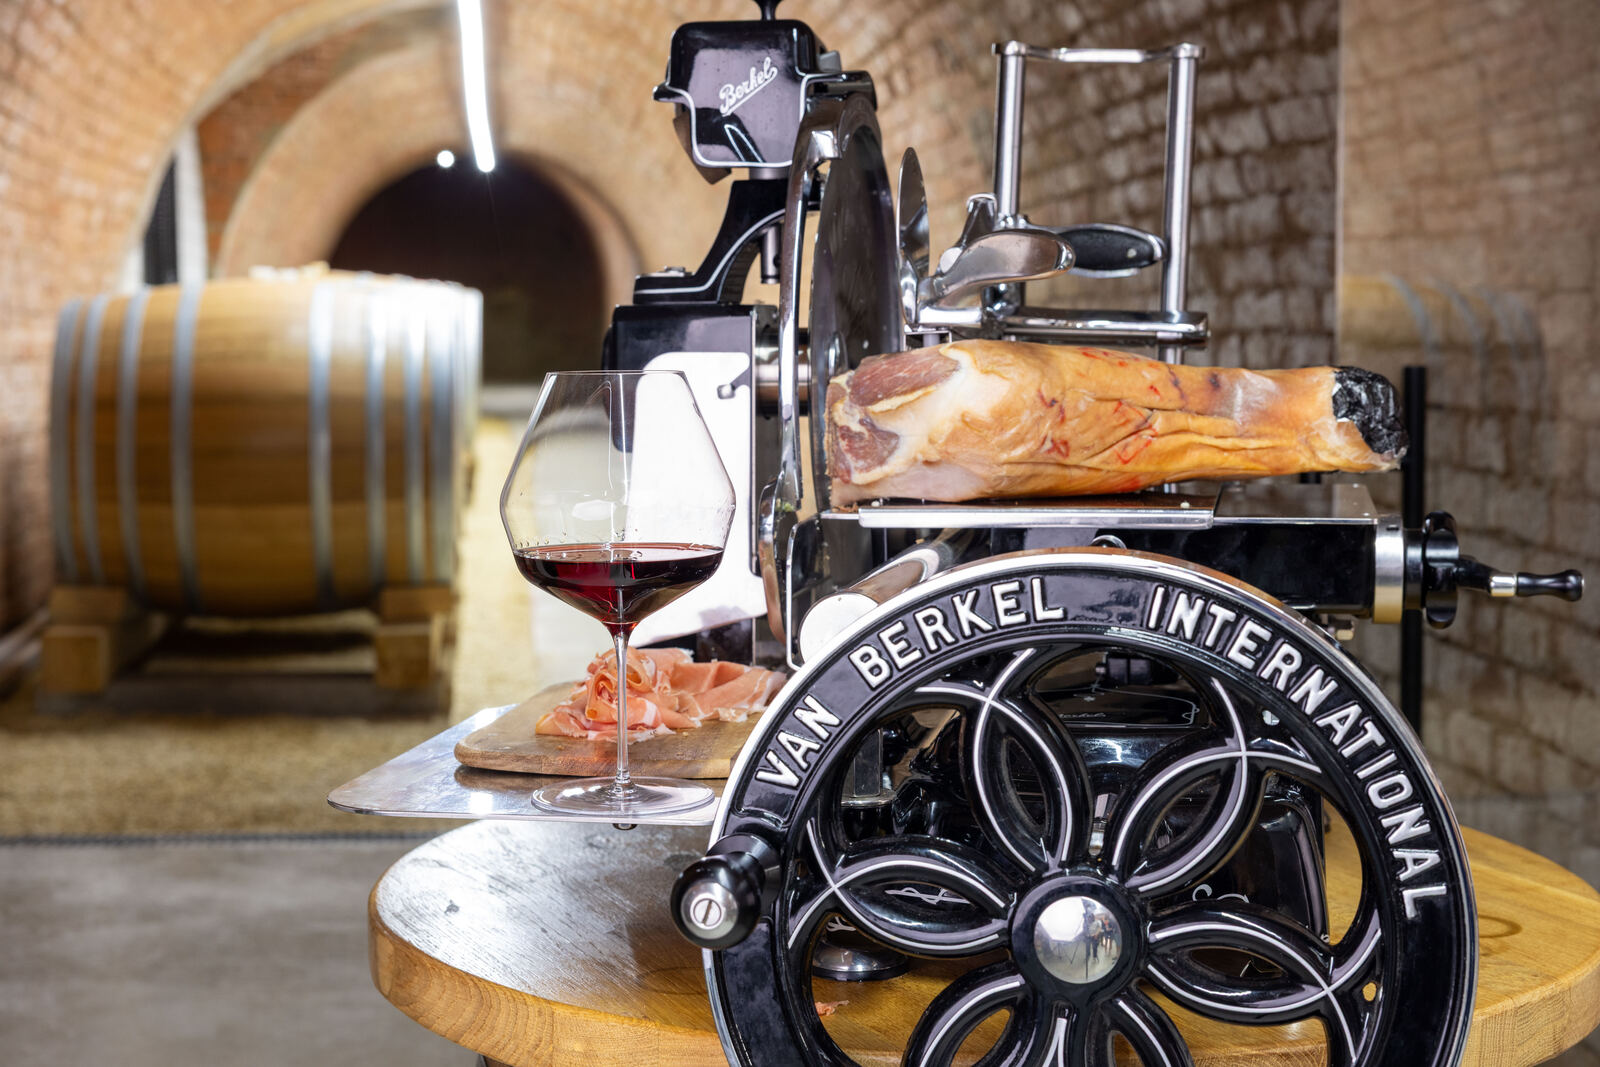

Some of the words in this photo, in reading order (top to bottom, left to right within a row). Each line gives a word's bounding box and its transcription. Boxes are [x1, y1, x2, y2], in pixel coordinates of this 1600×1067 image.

[719, 57, 778, 117] Berkel
[755, 695, 842, 788] VAN
[849, 577, 1065, 690] BERKEL
[1147, 586, 1447, 919] INTERNATIONAL
